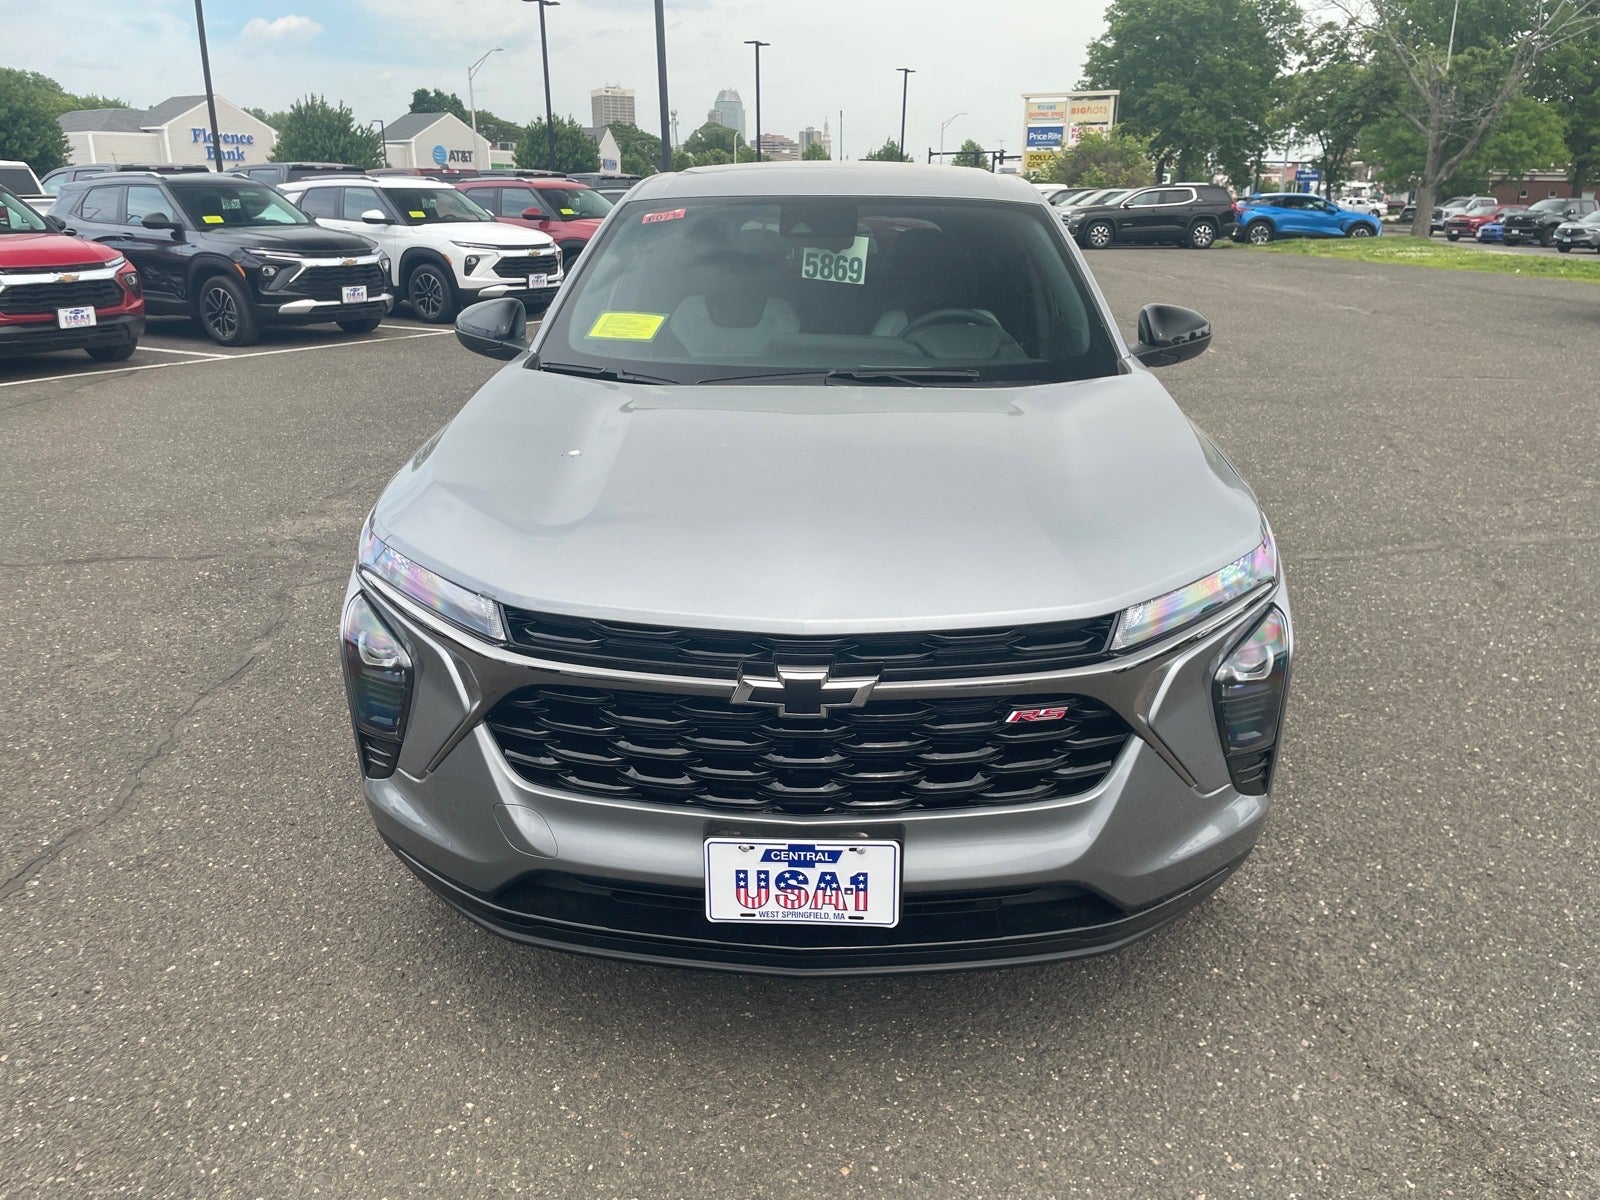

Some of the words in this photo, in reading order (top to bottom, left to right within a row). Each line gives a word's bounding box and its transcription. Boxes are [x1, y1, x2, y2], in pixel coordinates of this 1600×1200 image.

[1029, 132, 1047, 141] Price
[1047, 131, 1062, 140] Rite
[448, 149, 474, 163] AT&T
[803, 252, 863, 283] 5869
[1005, 706, 1069, 723] RS
[770, 850, 833, 862] CENTRAL
[735, 869, 869, 912] USA-1
[758, 910, 781, 919] WEST
[833, 912, 845, 920] MA
